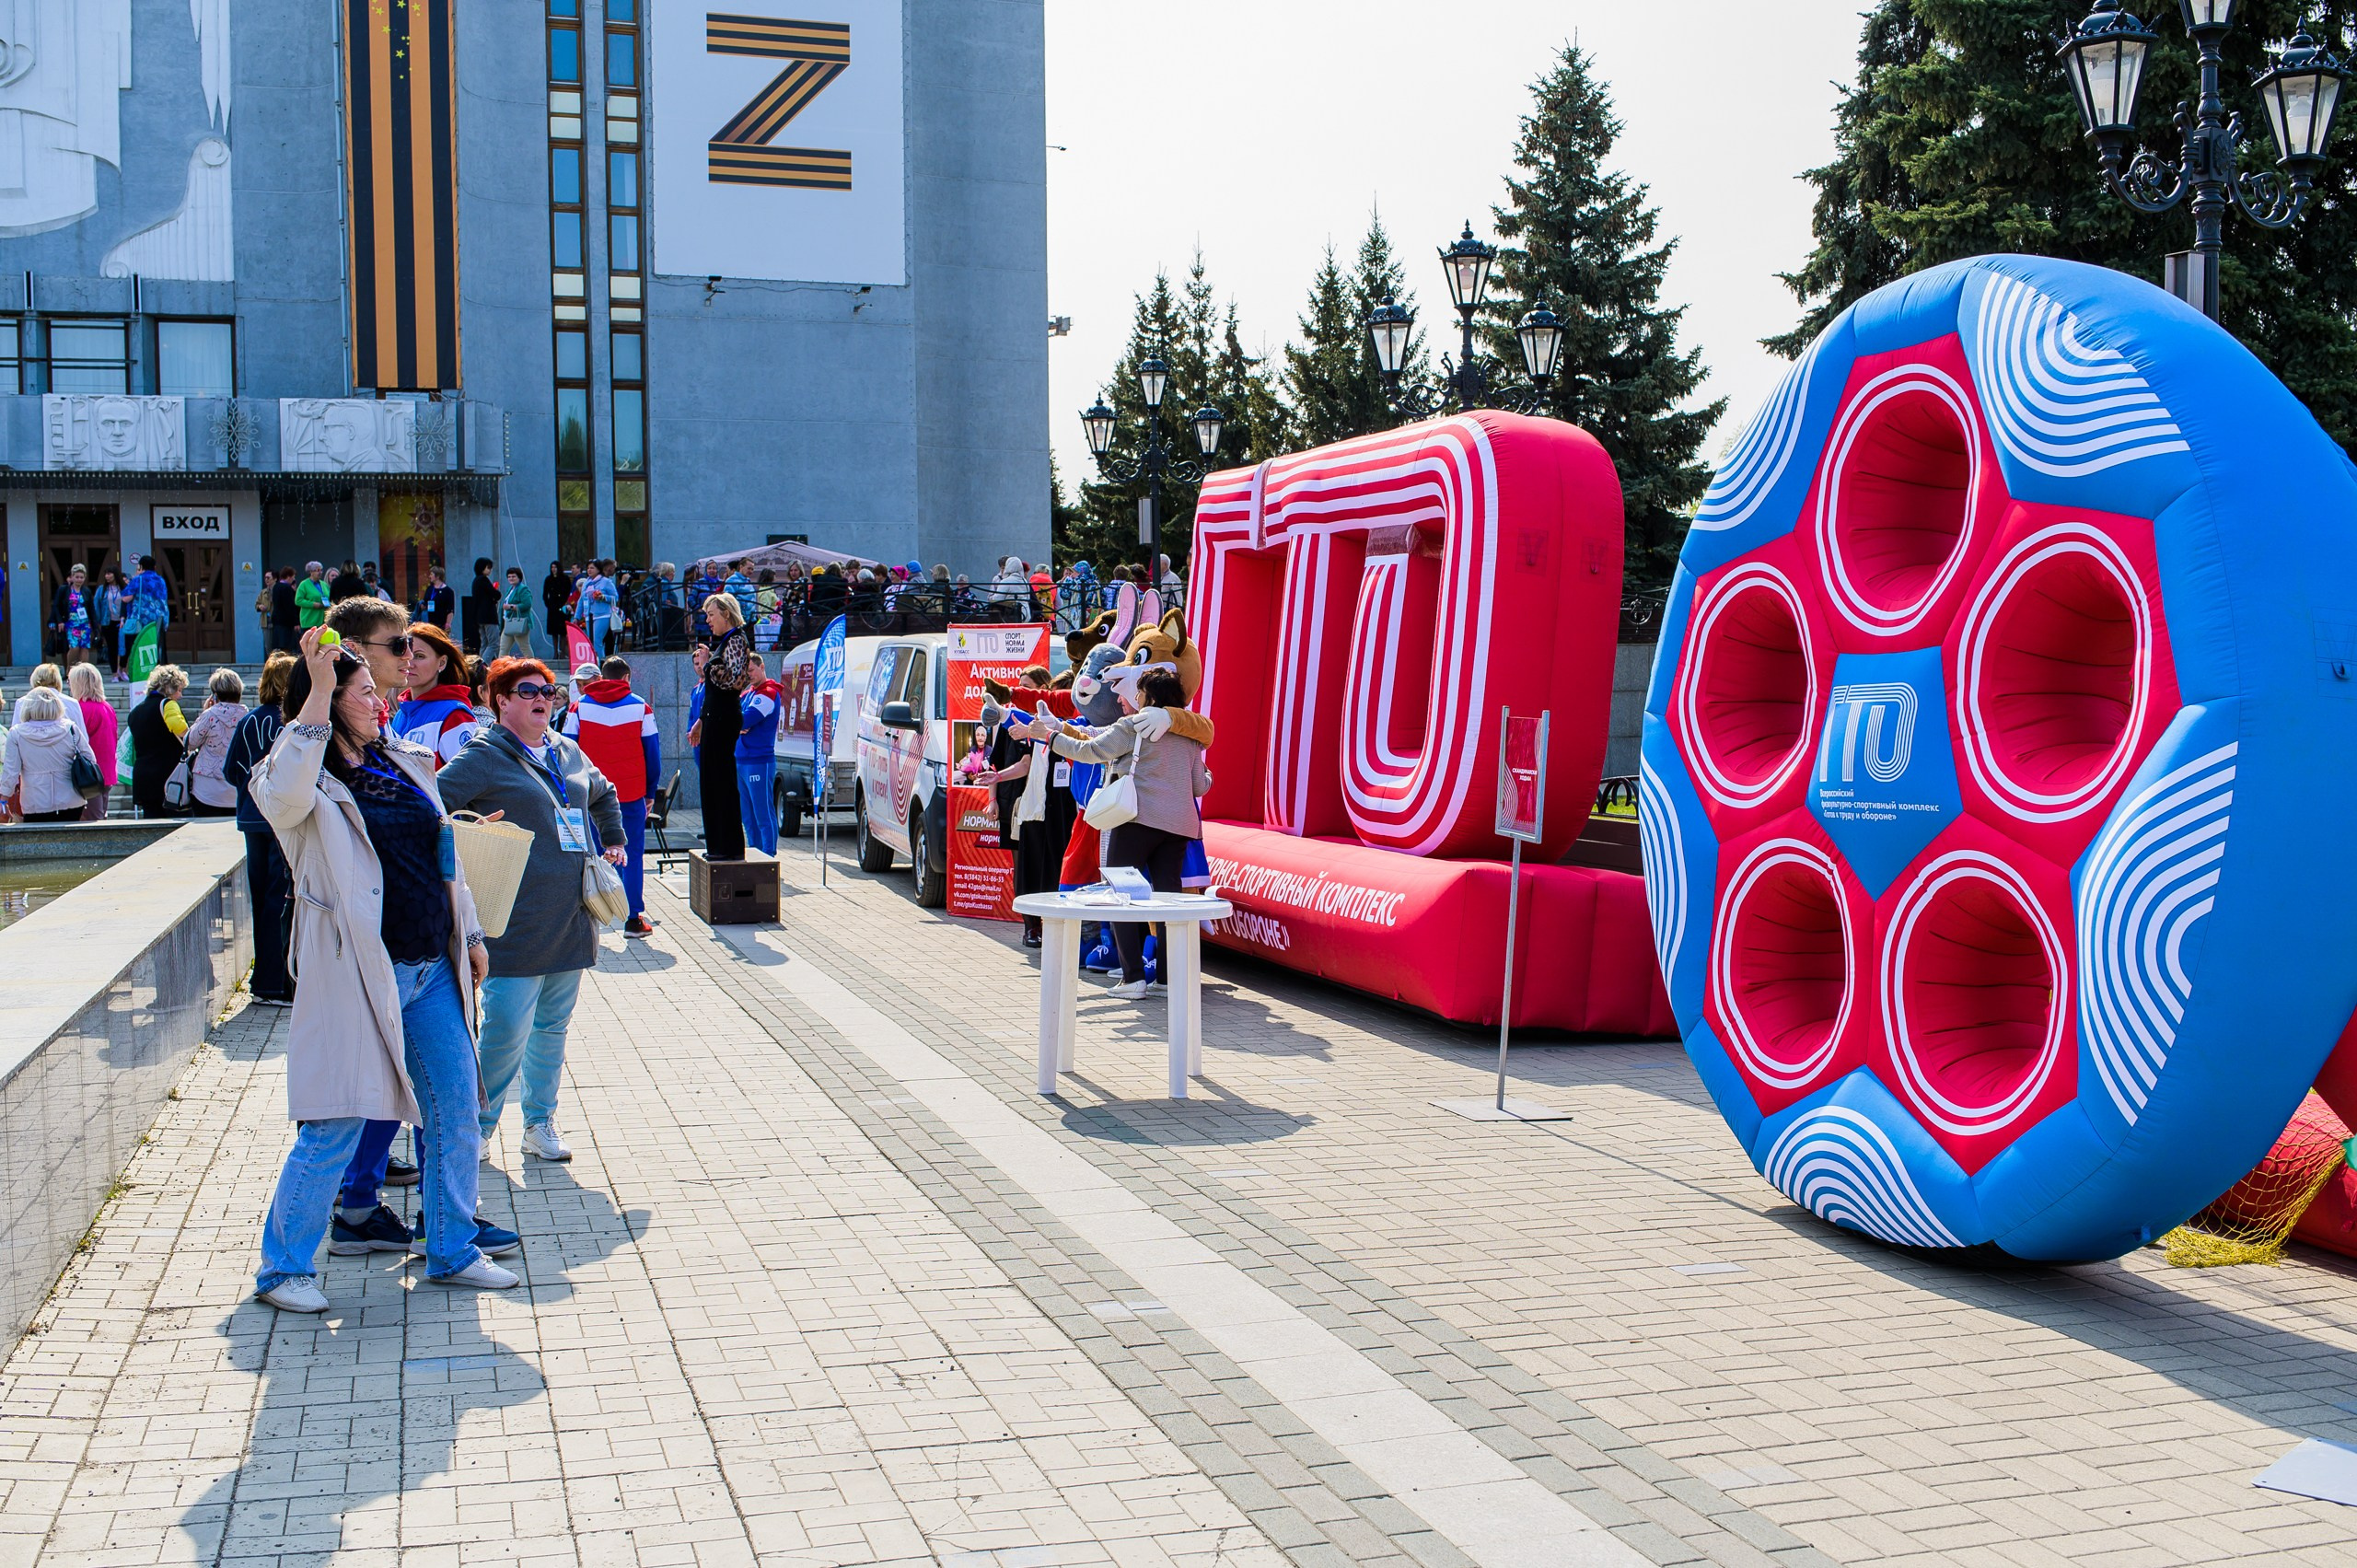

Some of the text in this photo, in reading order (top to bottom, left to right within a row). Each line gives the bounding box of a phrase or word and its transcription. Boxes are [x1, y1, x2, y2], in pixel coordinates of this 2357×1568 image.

[707, 13, 853, 192] Z
[162, 516, 220, 532] ВХОД
[976, 633, 999, 654] ГТО
[970, 663, 1023, 679] Активно
[1819, 681, 1919, 783] ГТО
[749, 774, 761, 783] ГТО
[1819, 788, 1854, 798] Всероссийский
[1898, 802, 1940, 812] комплекс
[1861, 810, 1897, 821] обороне»
[1315, 881, 1406, 927] КОМПЛЕКС
